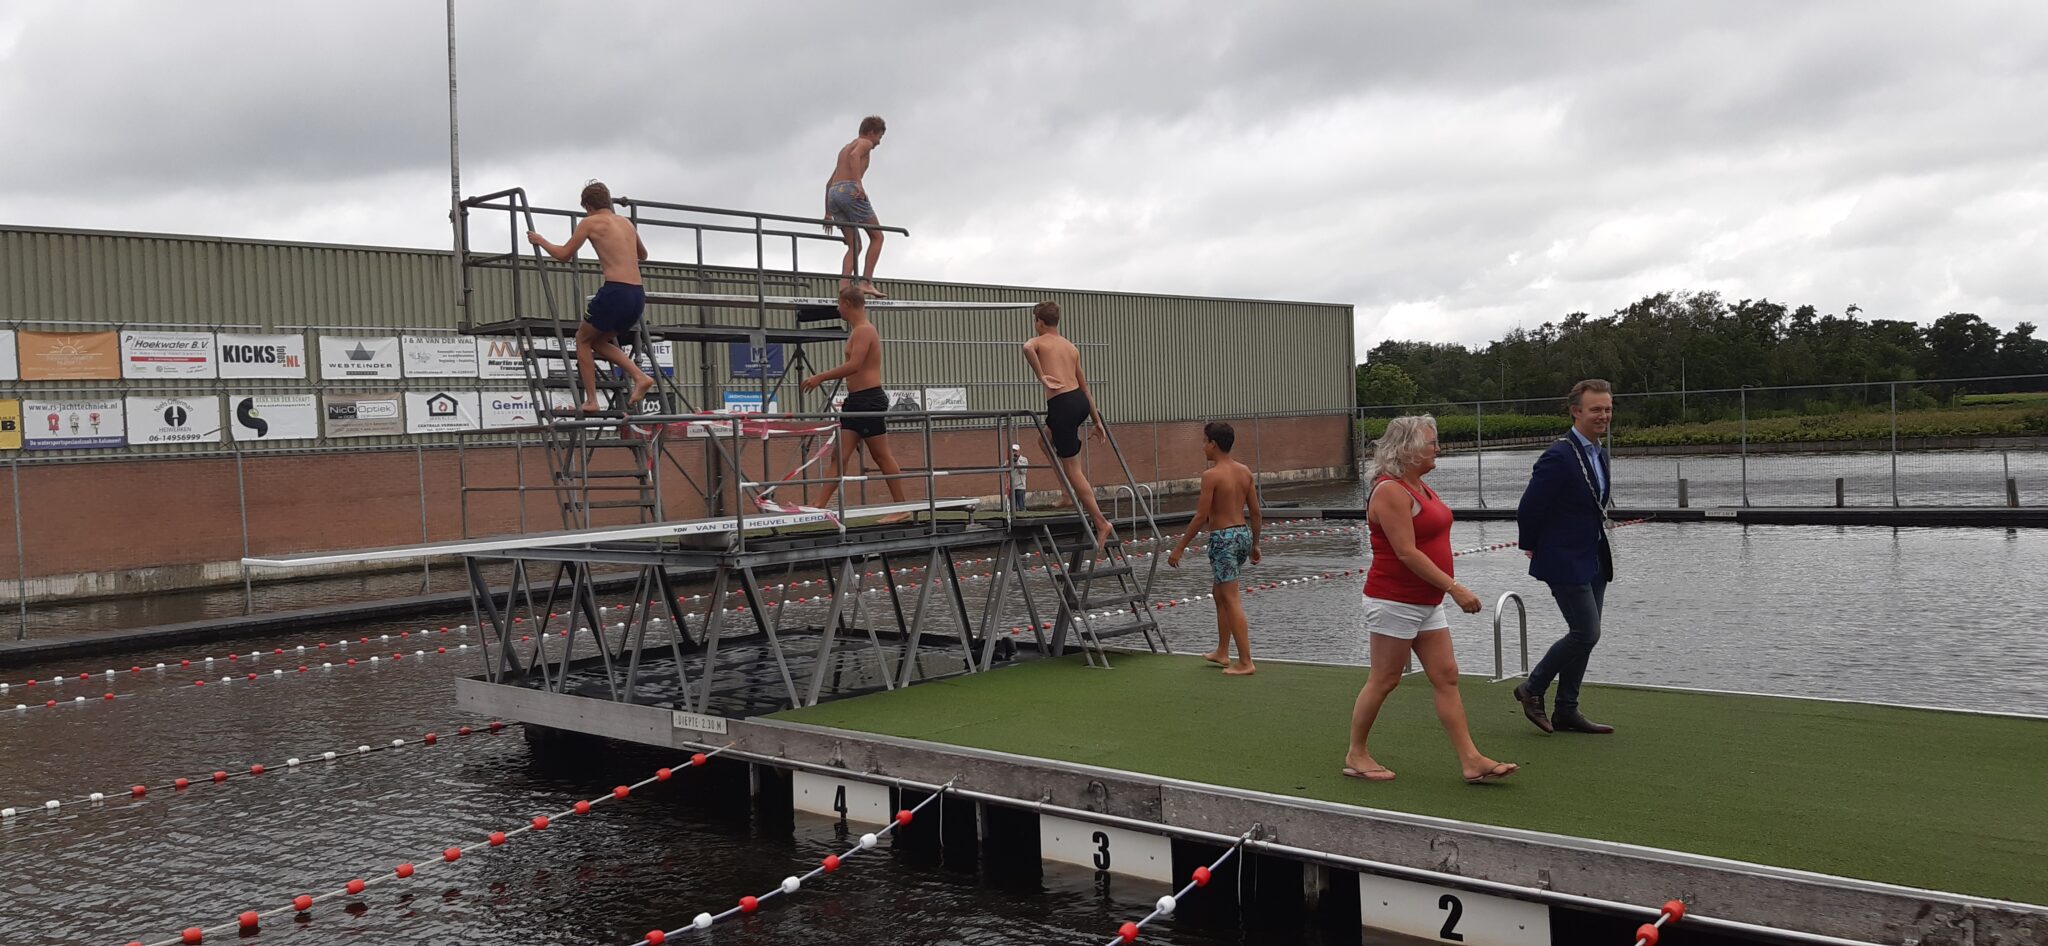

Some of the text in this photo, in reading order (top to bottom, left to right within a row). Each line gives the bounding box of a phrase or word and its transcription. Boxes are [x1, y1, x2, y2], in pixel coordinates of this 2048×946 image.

[134, 339, 209, 349] Hoekwater B.V.
[222, 345, 276, 363] KICKS
[276, 345, 287, 364] fotos
[282, 355, 300, 368] .NL
[28, 402, 118, 412] www.rs-jachttechniek.nl
[153, 397, 194, 413] Niels Offerman
[357, 405, 391, 414] Optiek
[149, 434, 201, 442] 06-14956999
[749, 519, 788, 528] HEUVEL
[833, 784, 848, 818] 4
[1092, 831, 1110, 870] 3
[1438, 894, 1464, 942] 2
